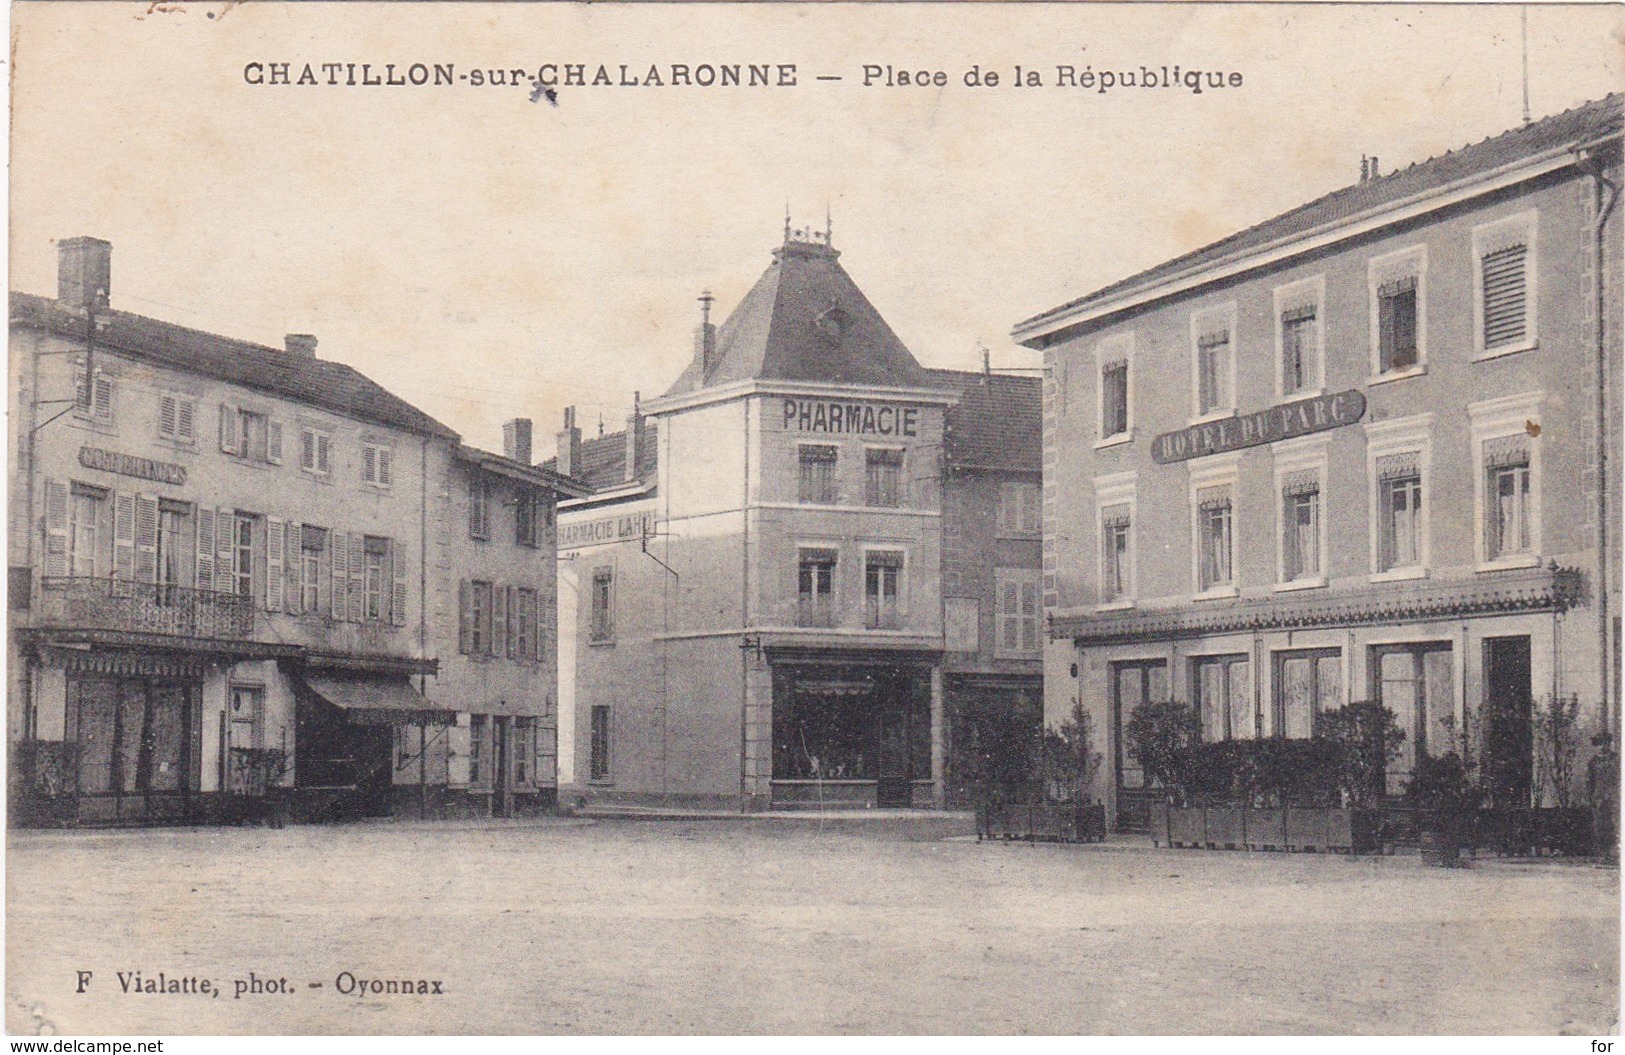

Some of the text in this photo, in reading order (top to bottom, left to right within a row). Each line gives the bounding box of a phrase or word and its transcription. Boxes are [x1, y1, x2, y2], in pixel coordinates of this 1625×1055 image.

[783, 400, 919, 437] PHARMACIE
[1161, 396, 1346, 459] HOTEL DU PARC
[558, 521, 613, 545] HARMACIE
